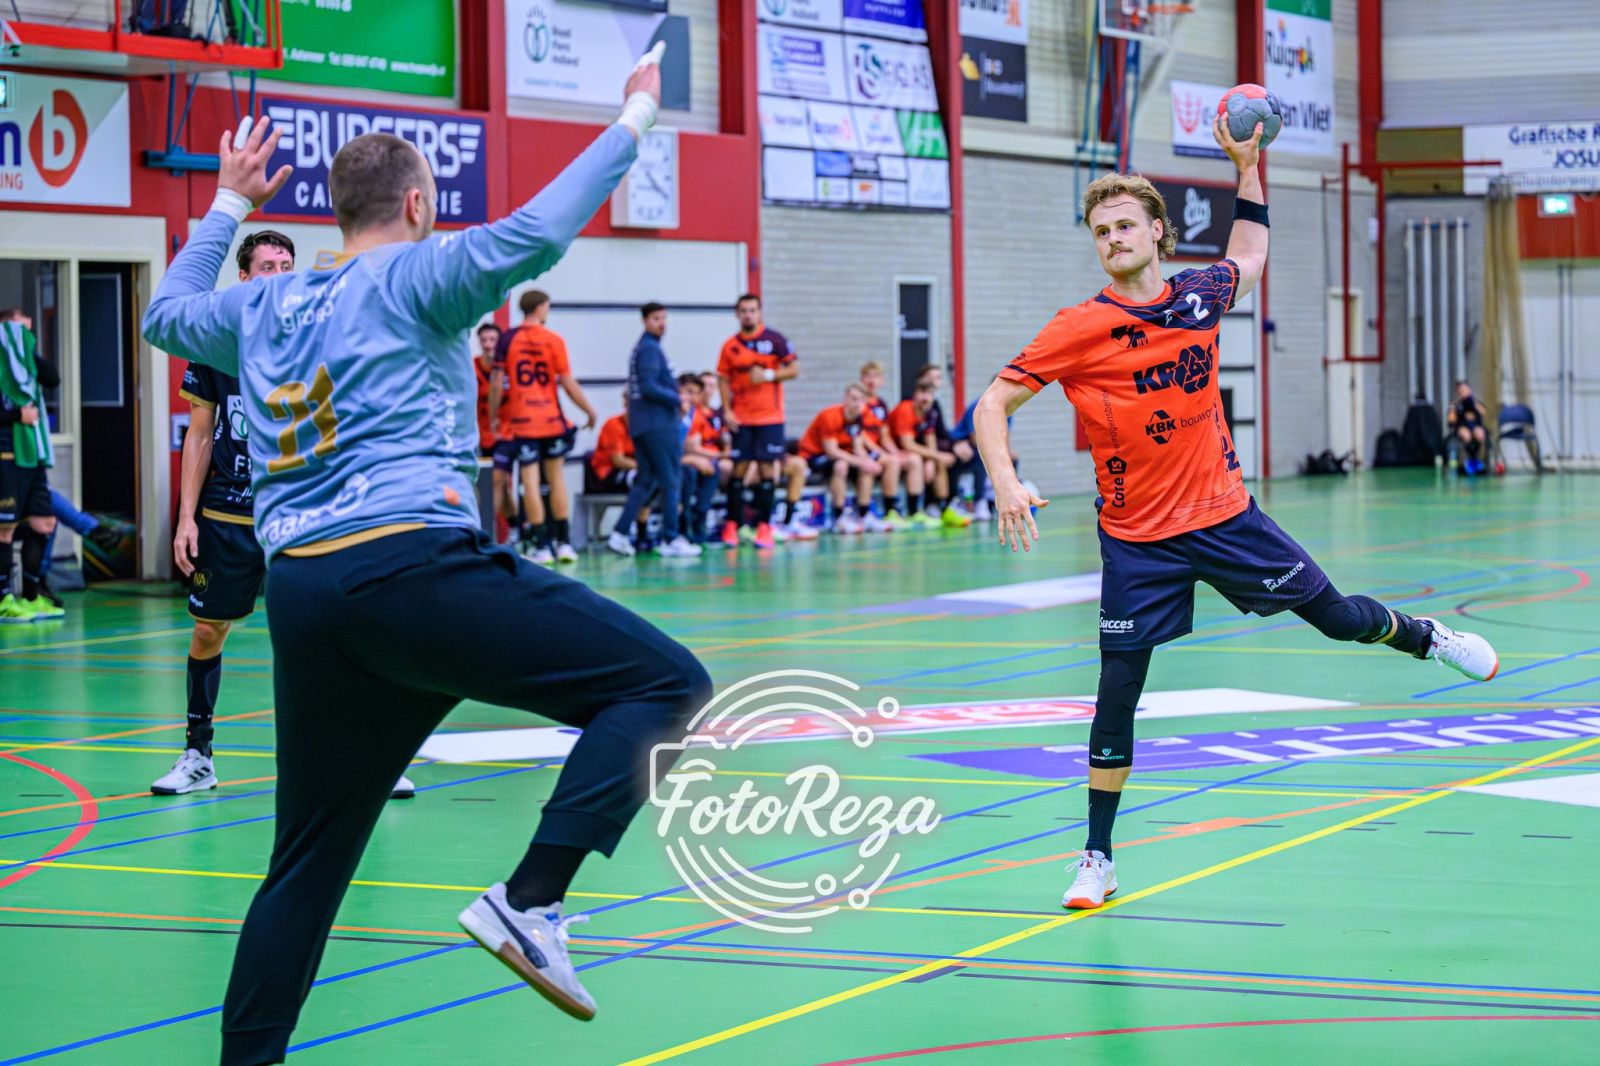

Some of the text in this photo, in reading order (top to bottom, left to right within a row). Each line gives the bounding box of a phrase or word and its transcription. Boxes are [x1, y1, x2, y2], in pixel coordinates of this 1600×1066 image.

[295, 108, 463, 178] BURS
[1508, 124, 1586, 147] Grafische
[1186, 293, 1209, 320] 2
[516, 360, 549, 387] 66
[1145, 418, 1177, 436] KBK
[1112, 476, 1126, 509] Core
[1263, 560, 1306, 592] GLADIATOR
